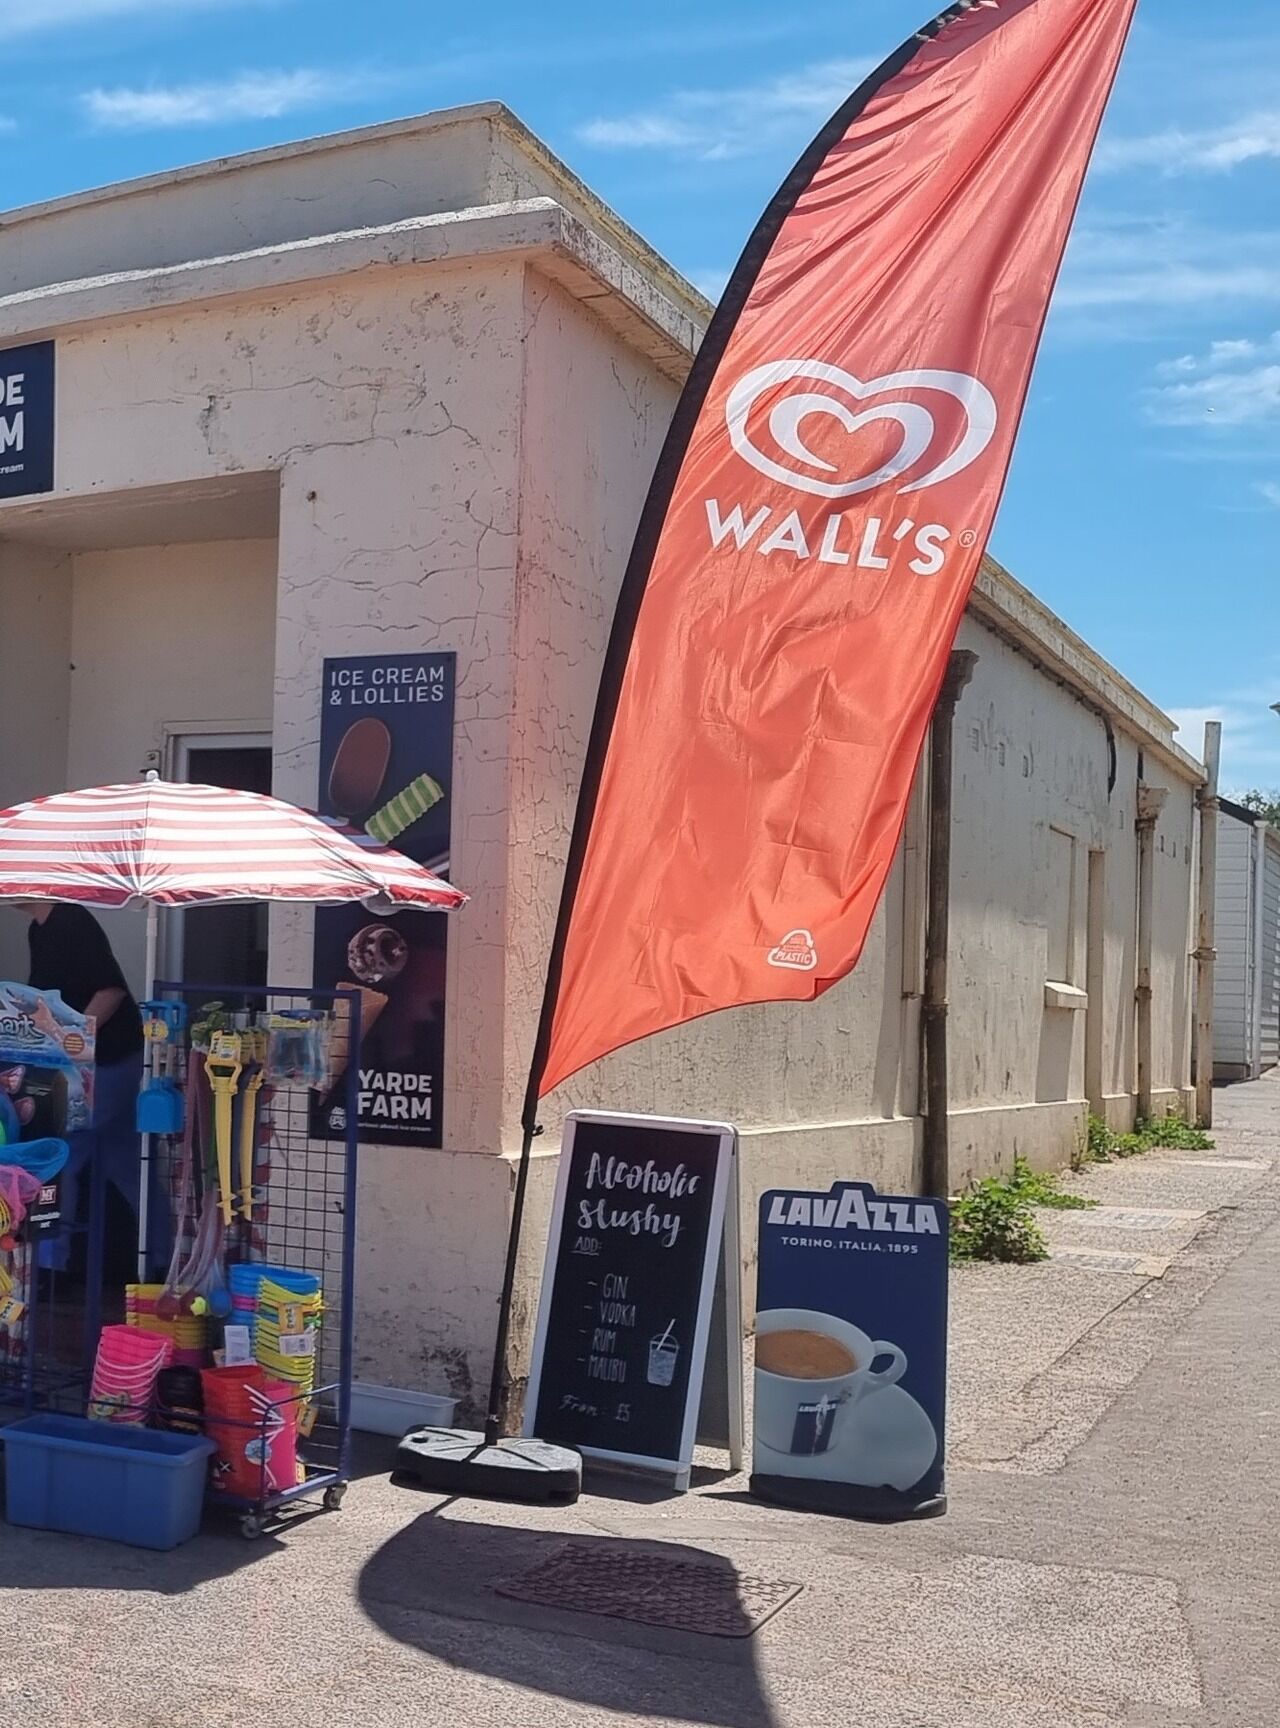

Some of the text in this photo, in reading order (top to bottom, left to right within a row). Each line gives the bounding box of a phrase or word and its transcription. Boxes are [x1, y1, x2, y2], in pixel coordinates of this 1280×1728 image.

[704, 498, 951, 576] WALL'S
[331, 666, 444, 687] ICE CREAM
[330, 684, 444, 705] & LOLLIES
[775, 951, 811, 964] PLASTIC
[358, 1069, 432, 1094] YARDE
[357, 1092, 432, 1120] FARM
[584, 1152, 700, 1198] Alcoholic
[578, 1198, 682, 1248] Slushy
[767, 1189, 941, 1234] LAVAZZA
[603, 1273, 629, 1299] GIN
[600, 1301, 636, 1327] VODKA
[592, 1327, 616, 1353] RUM
[588, 1355, 627, 1383] MALIBU
